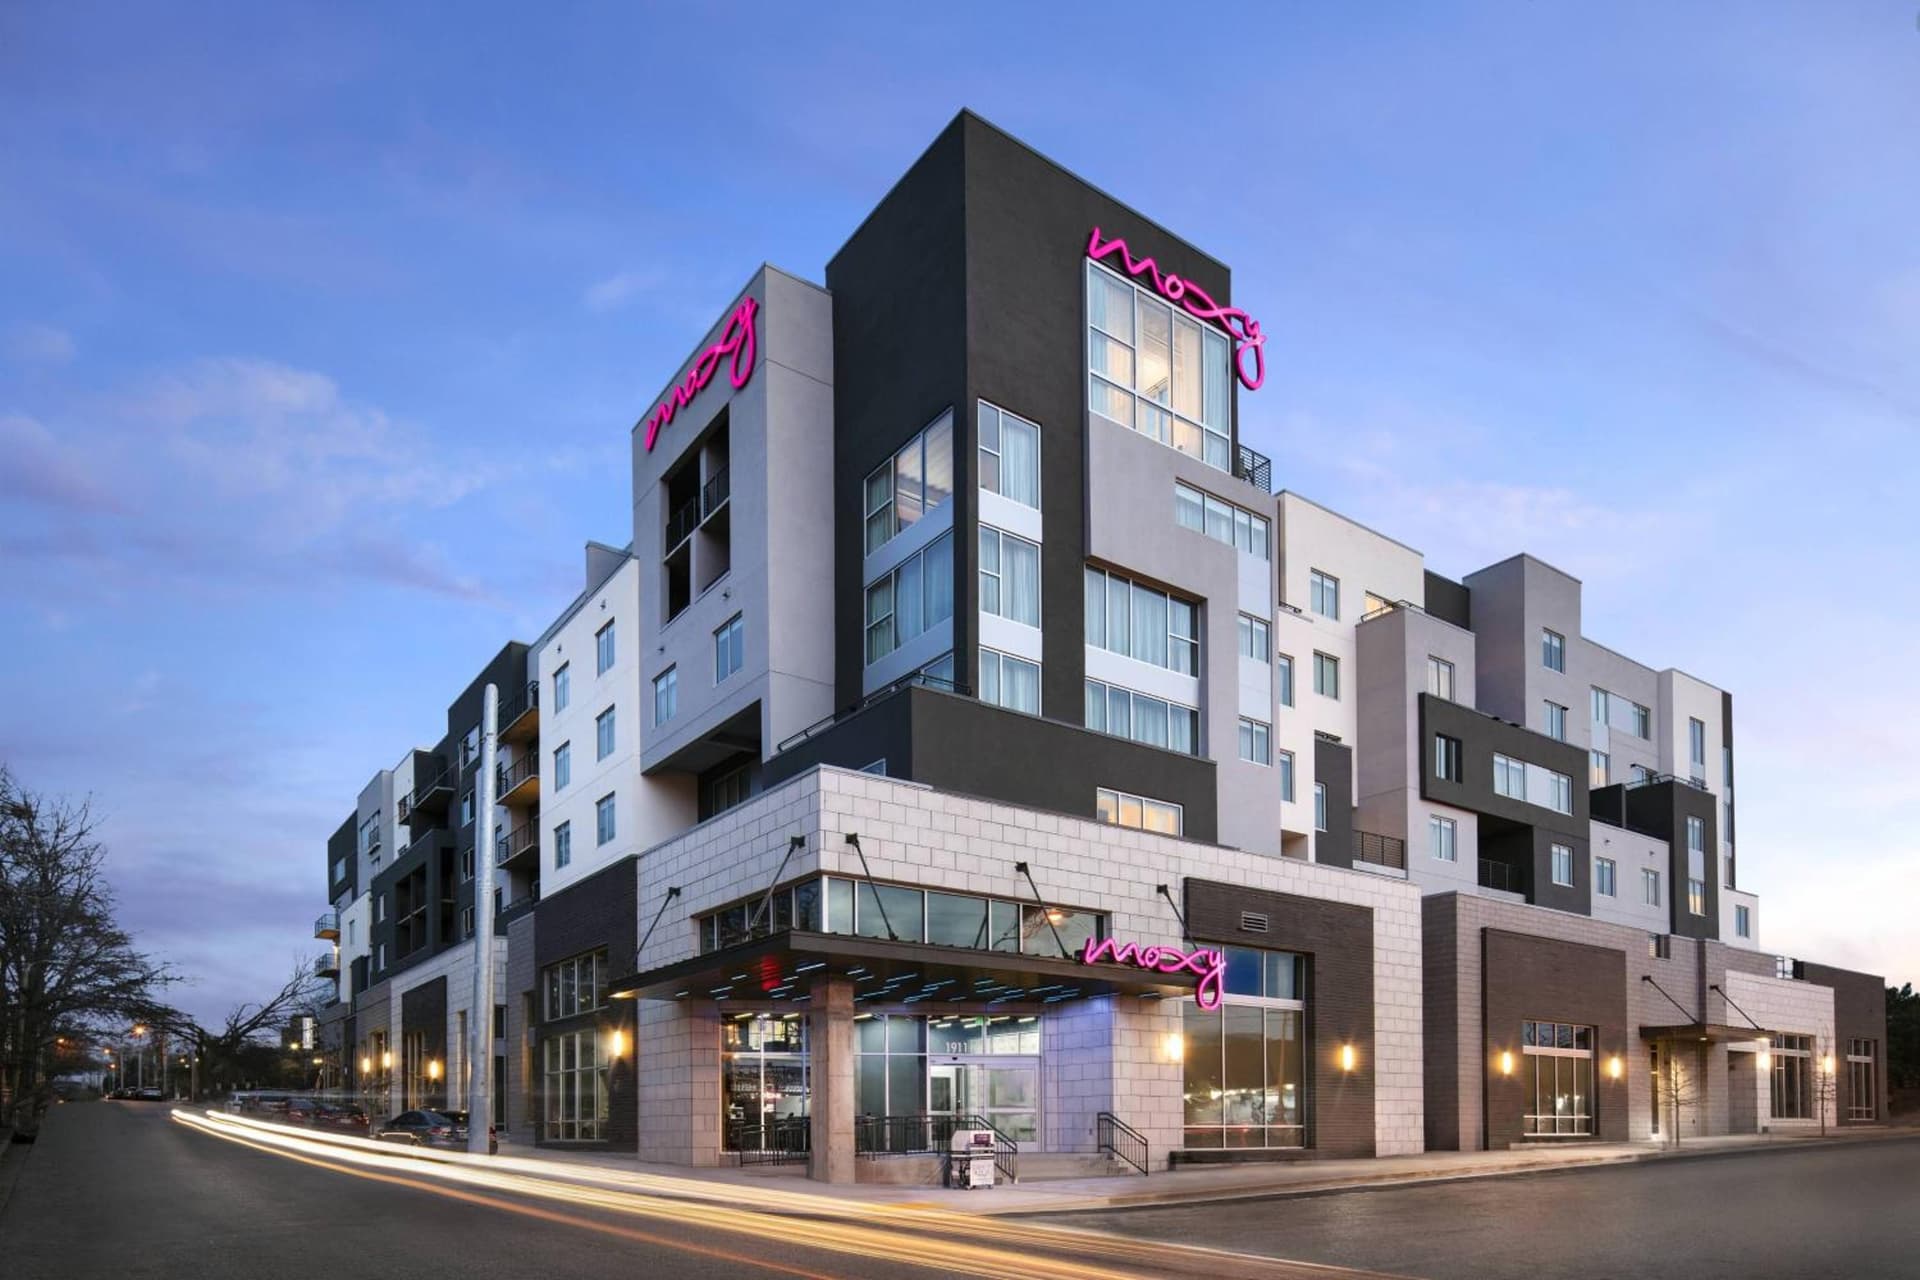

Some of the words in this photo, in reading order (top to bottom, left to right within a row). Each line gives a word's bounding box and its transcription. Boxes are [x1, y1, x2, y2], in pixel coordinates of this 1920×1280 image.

[1087, 226, 1267, 391] moxy
[1082, 936, 1227, 1011] moxy
[945, 1041, 968, 1053] 1911
